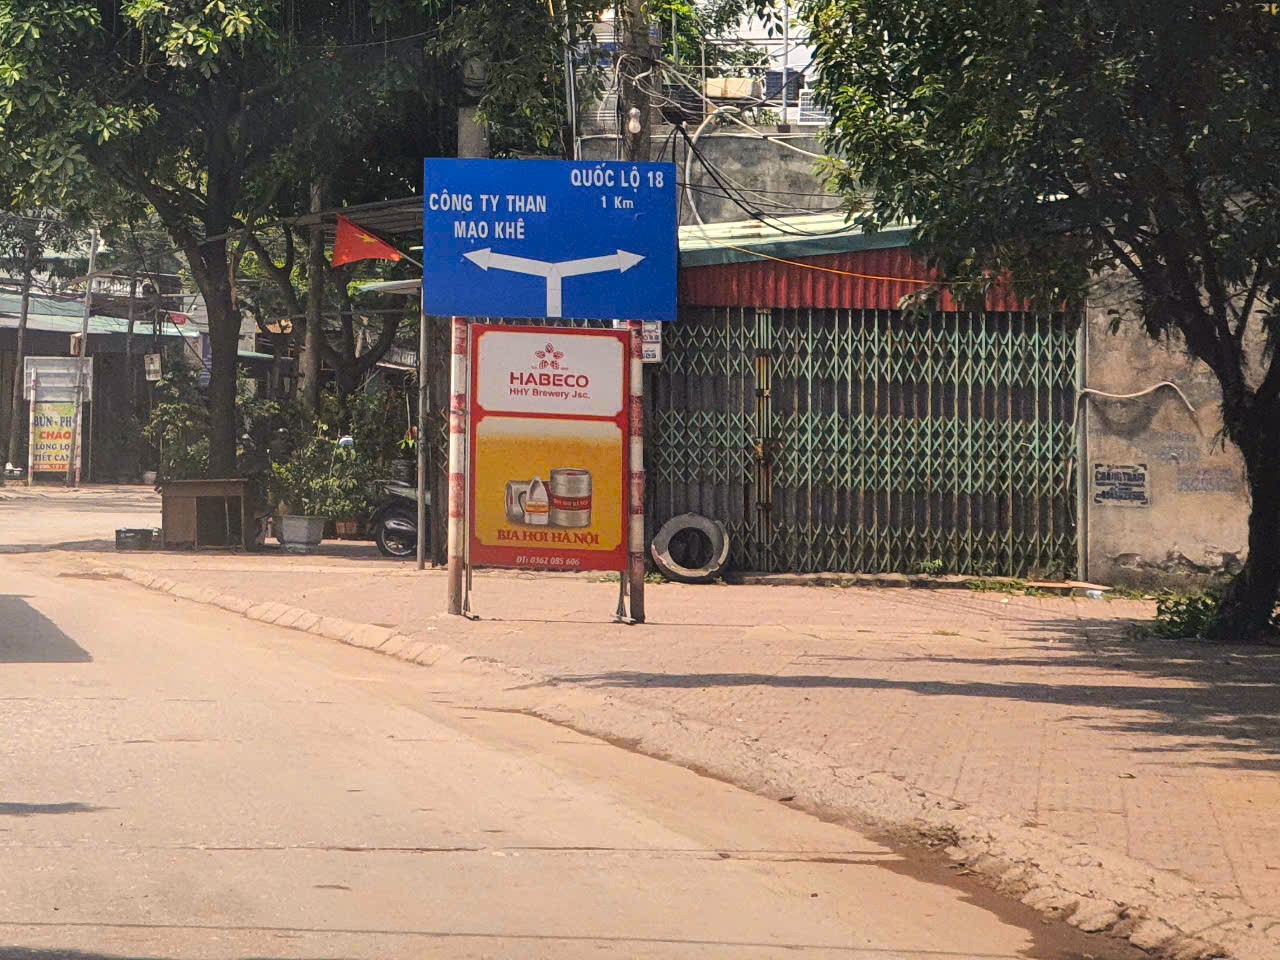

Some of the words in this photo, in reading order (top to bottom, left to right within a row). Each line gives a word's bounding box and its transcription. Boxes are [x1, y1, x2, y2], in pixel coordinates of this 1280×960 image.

[570, 162, 615, 187] QUỐC
[620, 166, 640, 192] LỘ
[647, 171, 665, 188] 18
[429, 189, 473, 212] CÔNG
[480, 194, 499, 212] TY
[505, 195, 547, 213] THAN
[601, 196, 607, 209] 1
[614, 196, 634, 209] Km
[454, 221, 489, 244] MẠO
[494, 217, 525, 239] KHÊ
[510, 371, 589, 388] HABECO
[509, 387, 530, 396] HHY
[532, 389, 569, 400] Brewery
[497, 529, 520, 541] BIA
[551, 530, 572, 543] HÀ
[573, 531, 600, 546] NỘI
